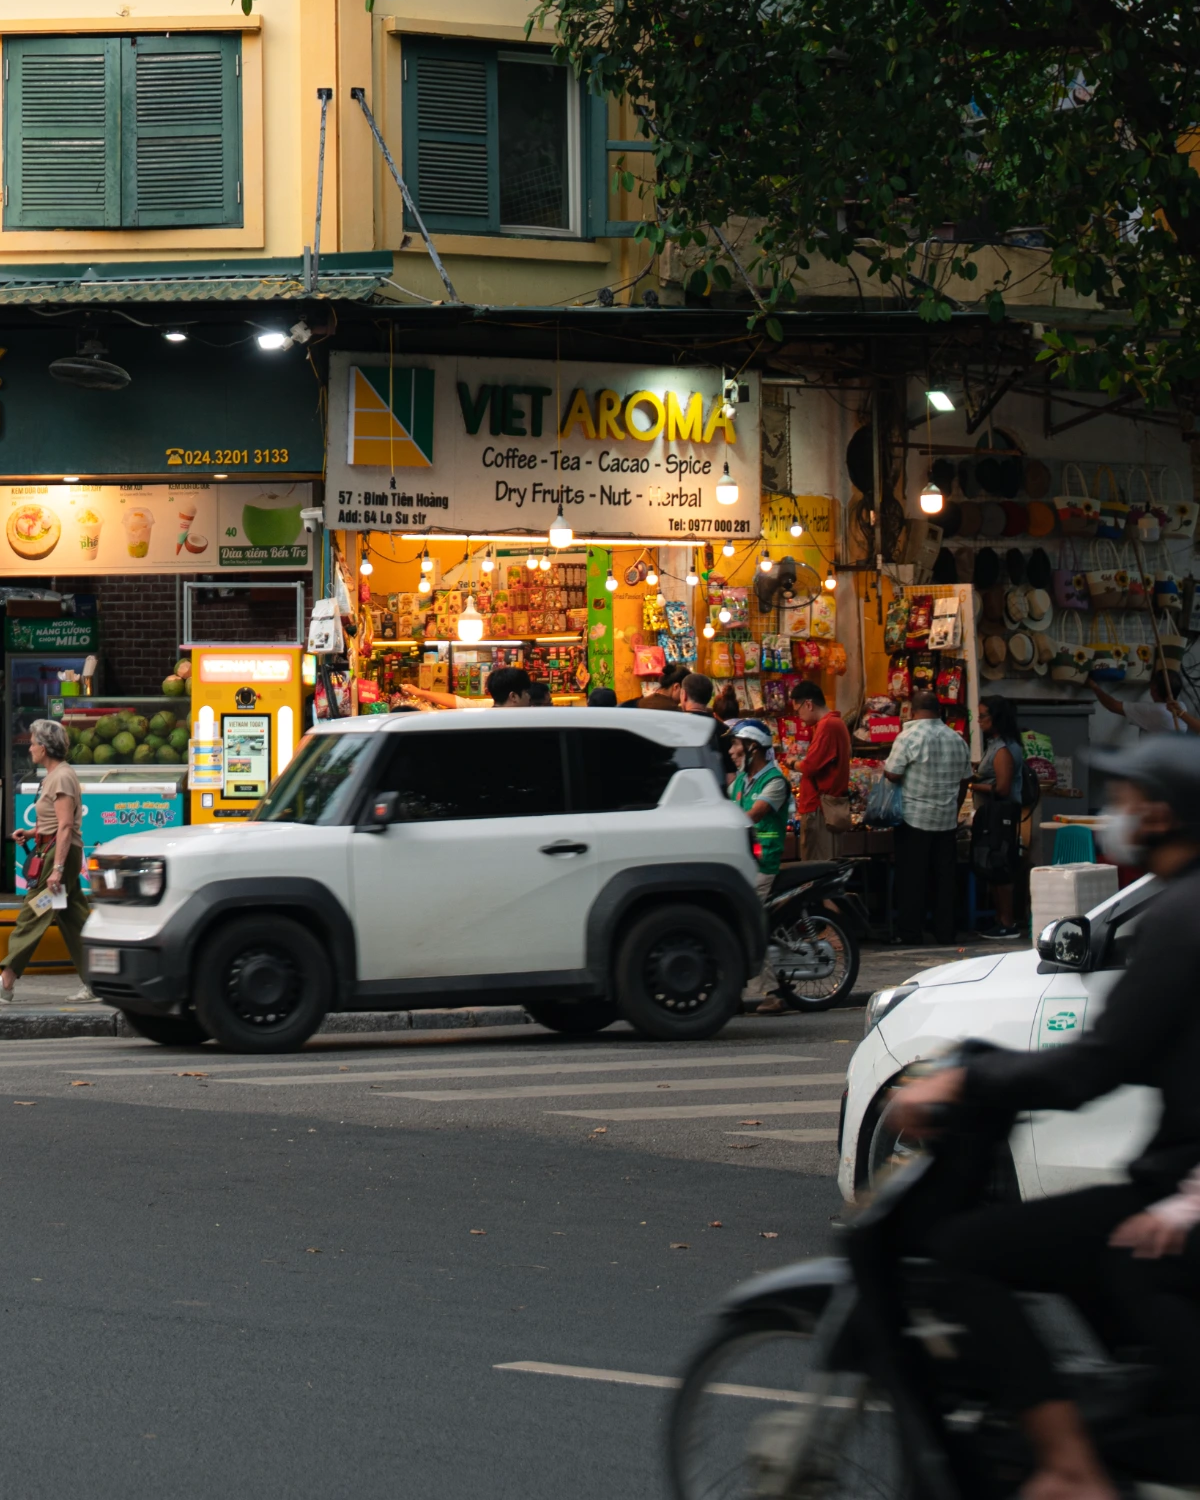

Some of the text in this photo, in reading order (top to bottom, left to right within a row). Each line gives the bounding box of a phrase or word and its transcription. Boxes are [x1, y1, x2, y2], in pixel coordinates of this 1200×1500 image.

[457, 381, 737, 445] VIET AROMA
[184, 448, 290, 466] 024.3201 3133
[481, 445, 712, 482] Coffee Tea Cacao Spice
[338, 491, 354, 505] 57
[391, 491, 414, 507] Tiên
[415, 492, 450, 510] Hoàng
[494, 480, 528, 509] Dry
[531, 482, 585, 507] Fruits
[599, 485, 633, 507] Nut
[338, 510, 427, 526] Add: 64 Lo Su str
[669, 518, 751, 533] Tel: 0977 000 281
[225, 527, 237, 537] 40
[56, 635, 90, 646] MILO
